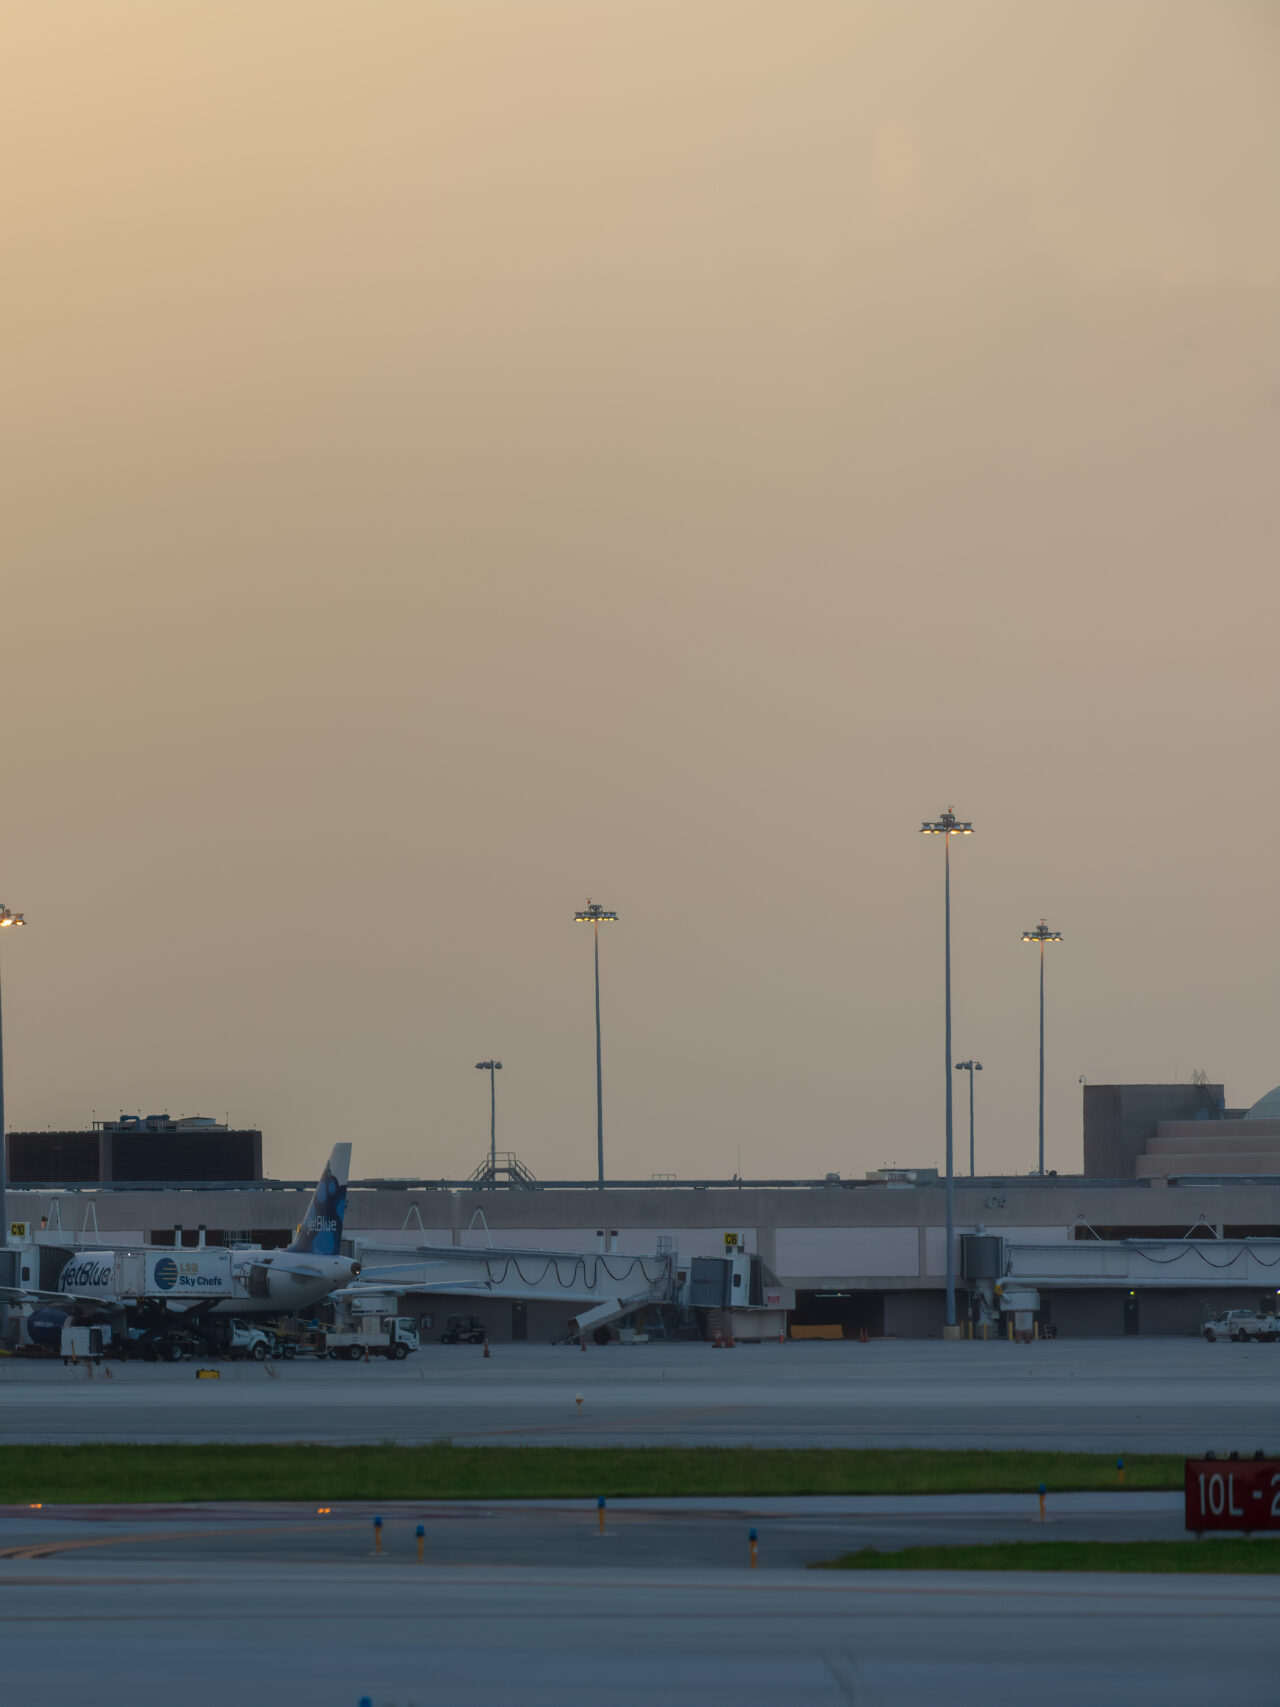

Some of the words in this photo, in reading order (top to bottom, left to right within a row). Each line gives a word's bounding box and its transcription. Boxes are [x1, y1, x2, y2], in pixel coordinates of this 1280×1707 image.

[11, 1224, 24, 1236] C10
[306, 1215, 337, 1235] jetBlue
[725, 1233, 737, 1245] C6
[61, 1261, 111, 1292] jetBlue
[179, 1275, 195, 1287] Sky
[197, 1275, 222, 1286] Chefs
[1199, 1473, 1243, 1516] 10L
